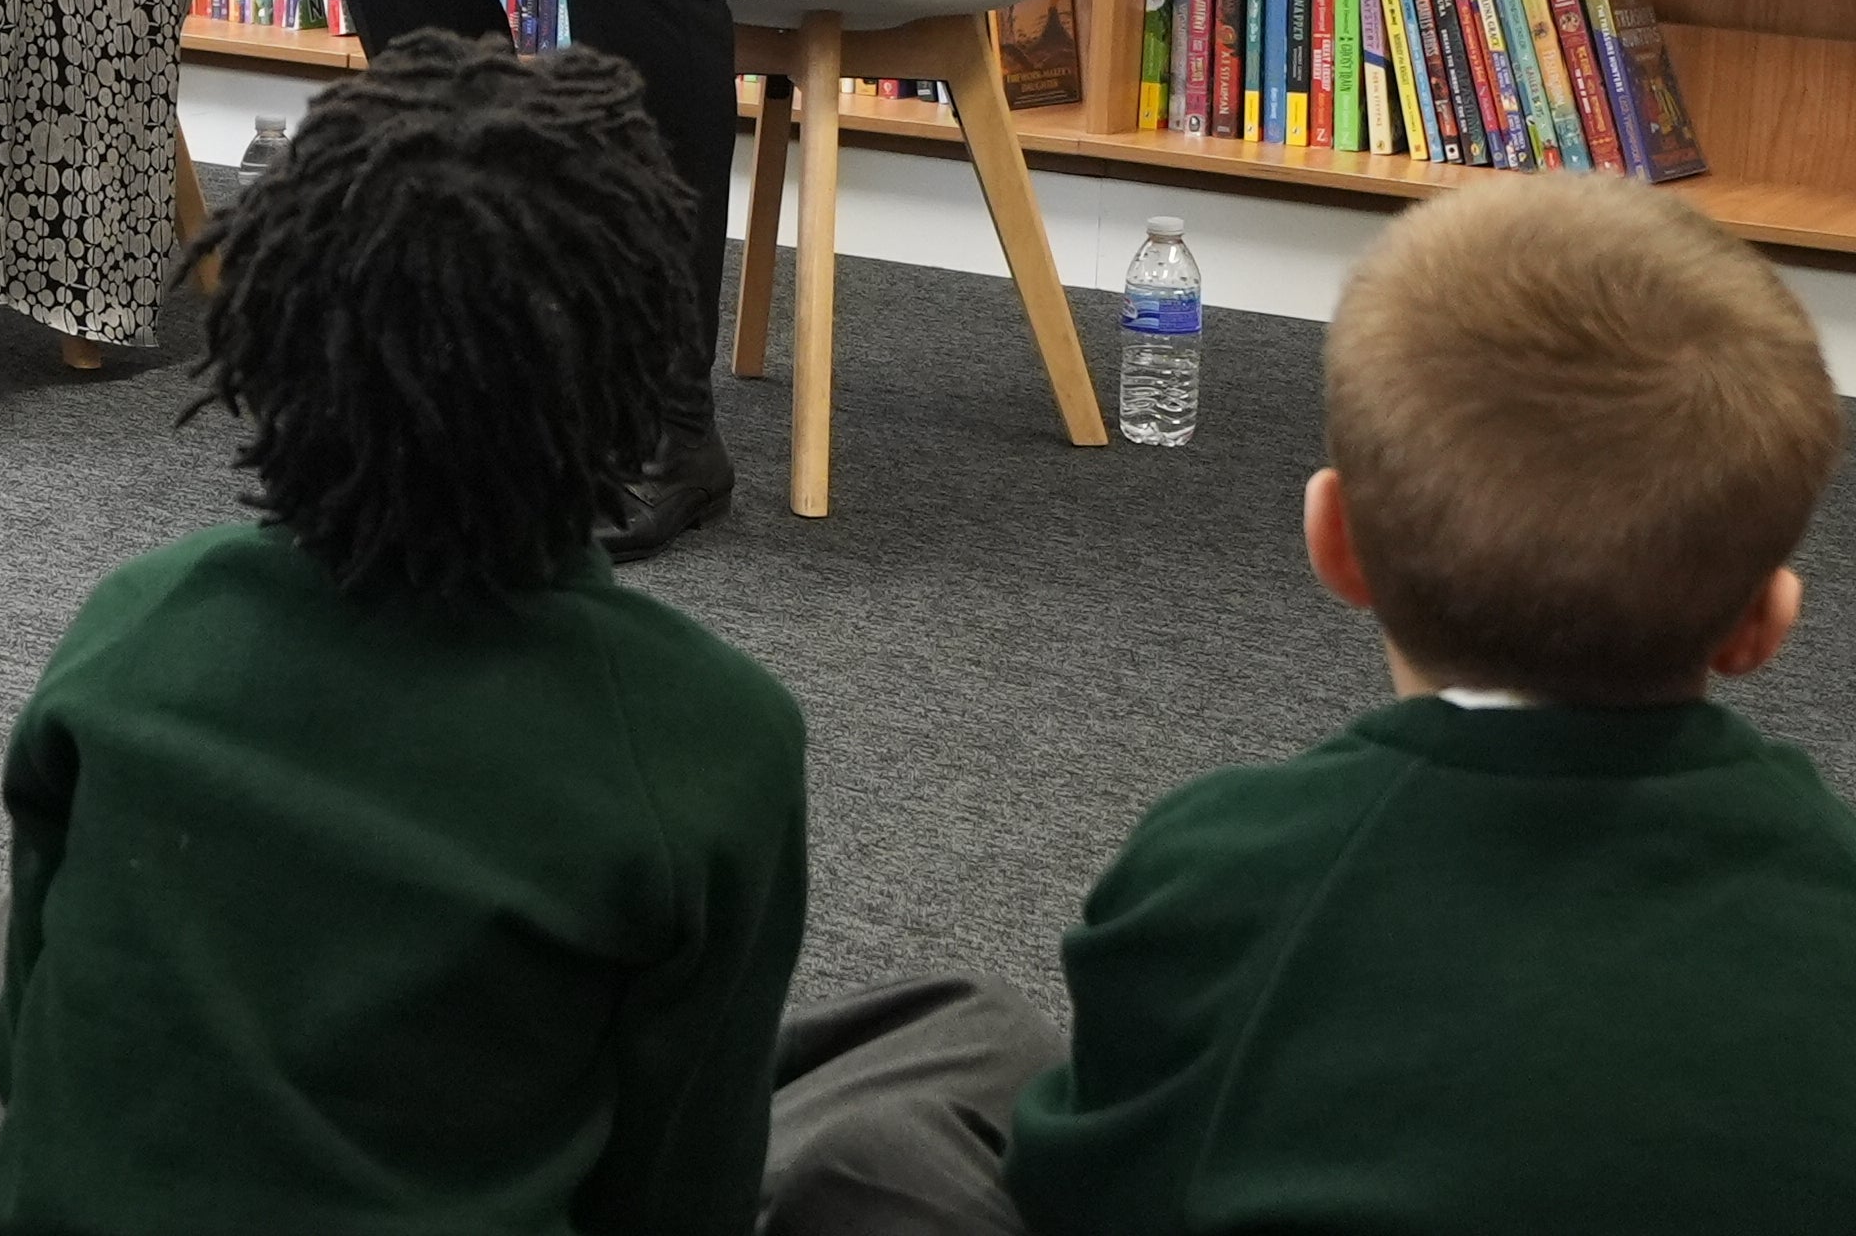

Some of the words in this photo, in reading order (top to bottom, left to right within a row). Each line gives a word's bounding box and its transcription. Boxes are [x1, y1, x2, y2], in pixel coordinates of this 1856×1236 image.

[1414, 0, 1435, 29] CHARLES
[1596, 5, 1606, 18] THE
[1487, 21, 1500, 48] GRACE
[1598, 19, 1613, 55] TREASURE
[1340, 43, 1352, 69] GHOST
[1321, 62, 1331, 91] AIRSHIP
[1339, 70, 1351, 92] TRAIN
[1449, 69, 1460, 94] MIRROR
[1608, 56, 1623, 92] HUNTERS
[1219, 67, 1230, 115] STEADMAN
